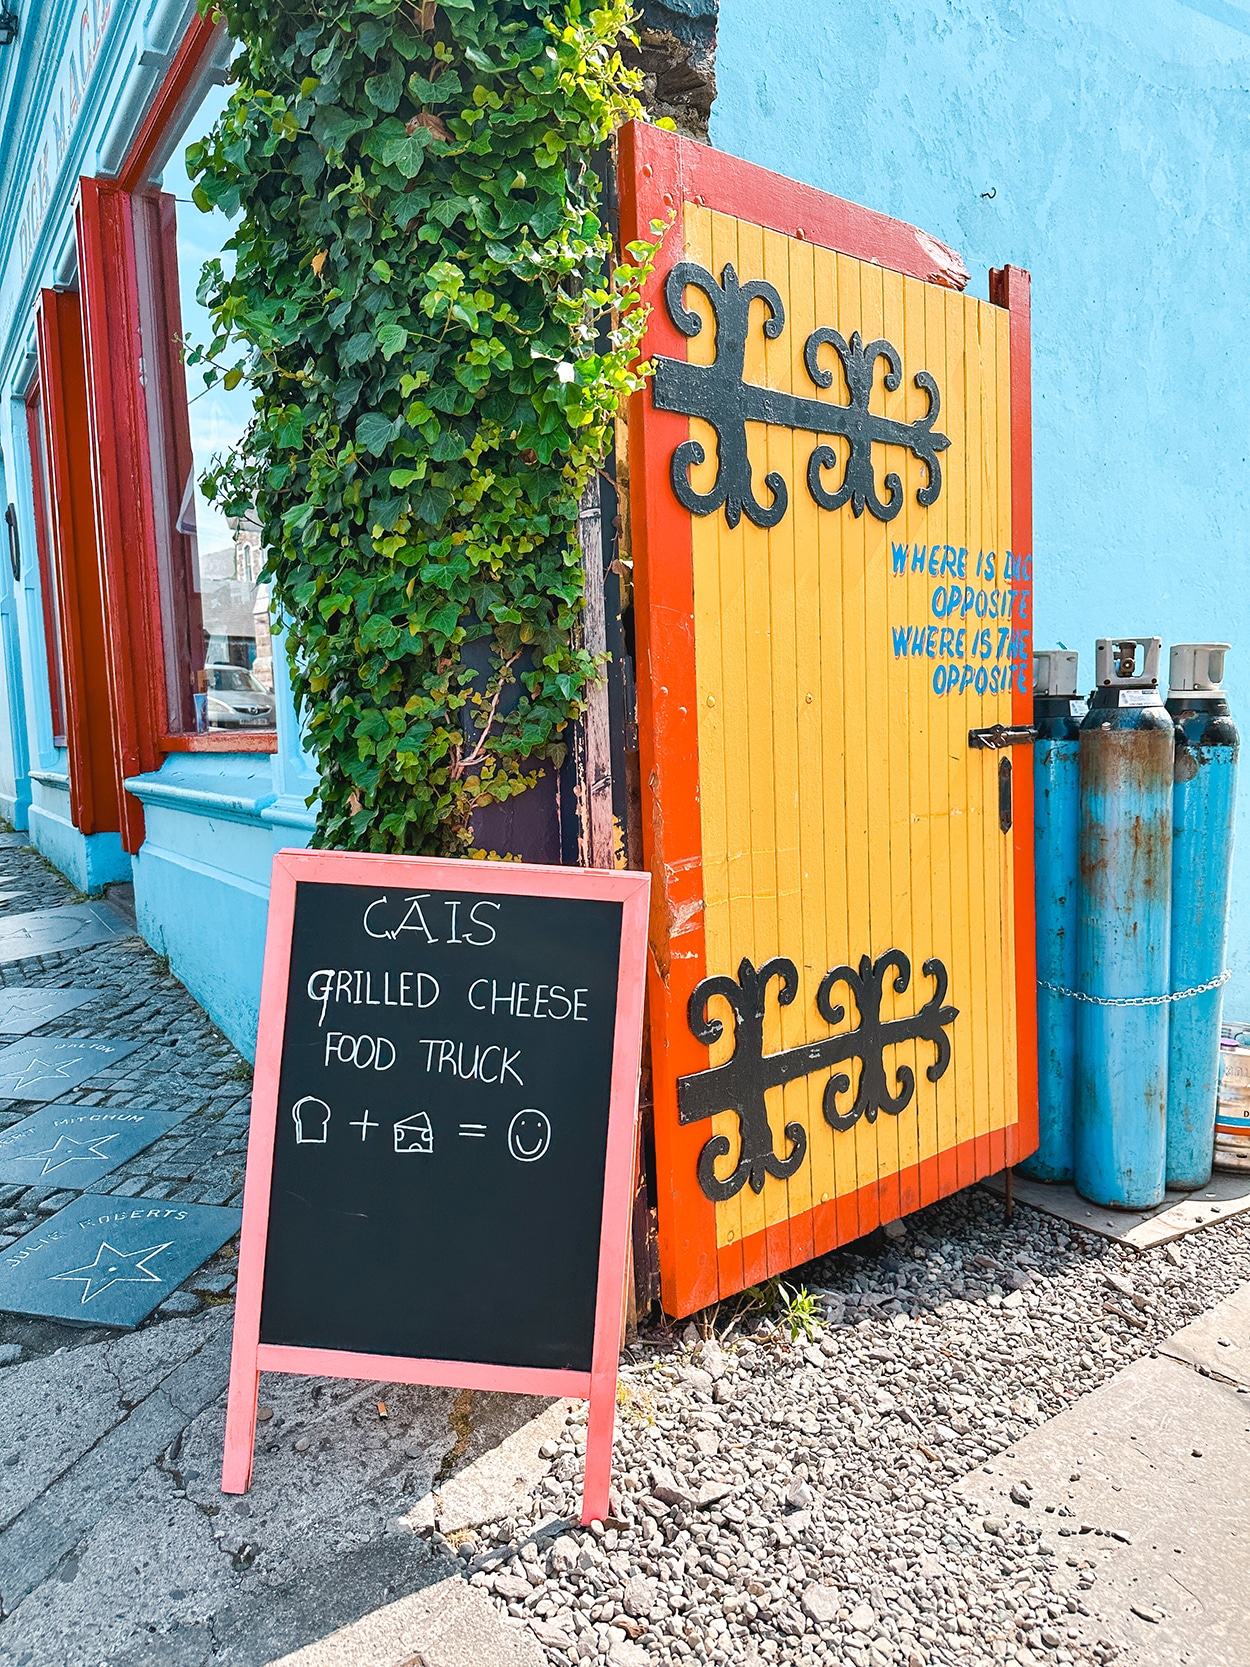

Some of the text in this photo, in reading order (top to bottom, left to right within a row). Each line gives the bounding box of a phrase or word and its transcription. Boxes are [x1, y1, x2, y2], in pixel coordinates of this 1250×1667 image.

[891, 541, 969, 579] WHERE
[976, 548, 996, 581] IS
[931, 585, 1030, 620] OPPOSITE
[891, 625, 1030, 660] WHERE IS THE
[932, 663, 1029, 697] OPPOSITE
[307, 969, 589, 1027] GRILLED CHEESE
[324, 1032, 524, 1086] FOOD TRUCK
[53, 1113, 145, 1127] MITCHUM
[5, 1208, 188, 1268] JULIE ROBERTS
